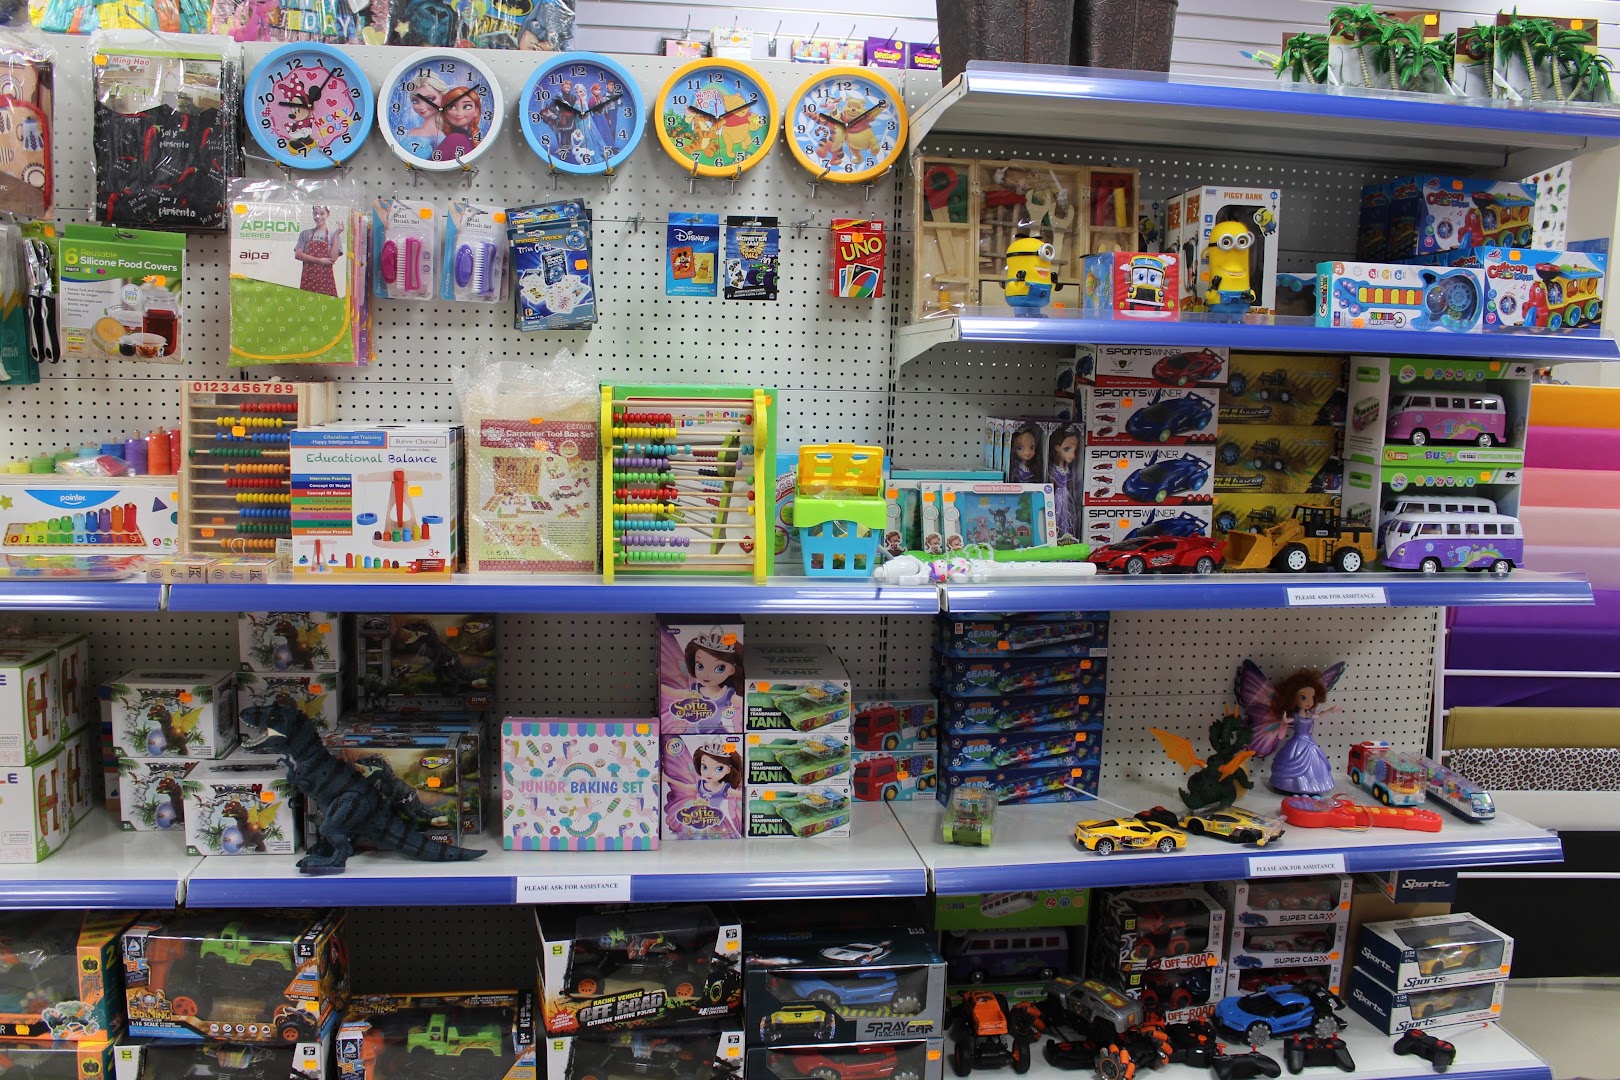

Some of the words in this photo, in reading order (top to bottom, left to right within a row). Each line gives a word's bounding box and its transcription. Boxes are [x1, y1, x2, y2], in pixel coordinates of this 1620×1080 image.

[112, 57, 131, 66] Ming
[134, 57, 149, 66] Hao
[286, 58, 303, 71] 12
[417, 67, 432, 78] 11
[439, 63, 456, 73] 12
[570, 66, 587, 77] 12
[268, 71, 284, 85] 11
[549, 74, 565, 84] 11
[706, 73, 723, 84] 12
[400, 81, 416, 92] 10
[686, 79, 701, 90] 11
[836, 81, 853, 92] 12
[258, 92, 275, 105] 10
[535, 90, 550, 101] 10
[816, 88, 831, 98] 11
[672, 95, 687, 105] 10
[801, 103, 817, 113] 10
[314, 107, 349, 128] MICKEY
[318, 117, 354, 137] MOUSE
[1223, 191, 1244, 200] PIGGY
[1245, 192, 1263, 201] BANK
[840, 236, 883, 262] UNO
[64, 247, 79, 265] 6
[80, 248, 118, 259] Reusable
[239, 249, 270, 261] aipa
[79, 256, 117, 268] Silicone
[118, 259, 143, 270] Food
[144, 261, 178, 272] Covers
[506, 429, 545, 438] Carpenter
[546, 430, 563, 438] Tool
[564, 430, 579, 438] Box
[306, 452, 382, 464] Educational
[388, 453, 438, 464] Balance
[428, 548, 440, 557] 3+
[1342, 592, 1376, 600] ASSISTANCE
[750, 716, 787, 728] TANK
[751, 770, 788, 782] TANK
[518, 780, 566, 794] JUNIOR
[570, 780, 618, 794] BAKING
[622, 780, 644, 794] SET
[751, 823, 788, 834] TANK
[524, 884, 549, 892] PLEASE
[579, 882, 619, 890] ASSISTANCE
[1401, 878, 1446, 891] Sports
[1279, 914, 1307, 922] SUPER
[300, 944, 311, 952] 3+
[1274, 957, 1301, 965] SUPER
[1361, 946, 1392, 970] Sports
[1403, 976, 1446, 988] Sports
[593, 996, 616, 1007] RACING
[617, 990, 643, 1002] VEHICLE
[1353, 989, 1384, 1013] Sports
[579, 1003, 613, 1022] OFF
[587, 1016, 613, 1027] EXTREME
[614, 1012, 636, 1022] MOTIVE
[636, 1007, 657, 1017] POWER
[864, 1020, 911, 1038] SPRAY
[1395, 1018, 1437, 1032] Sports
